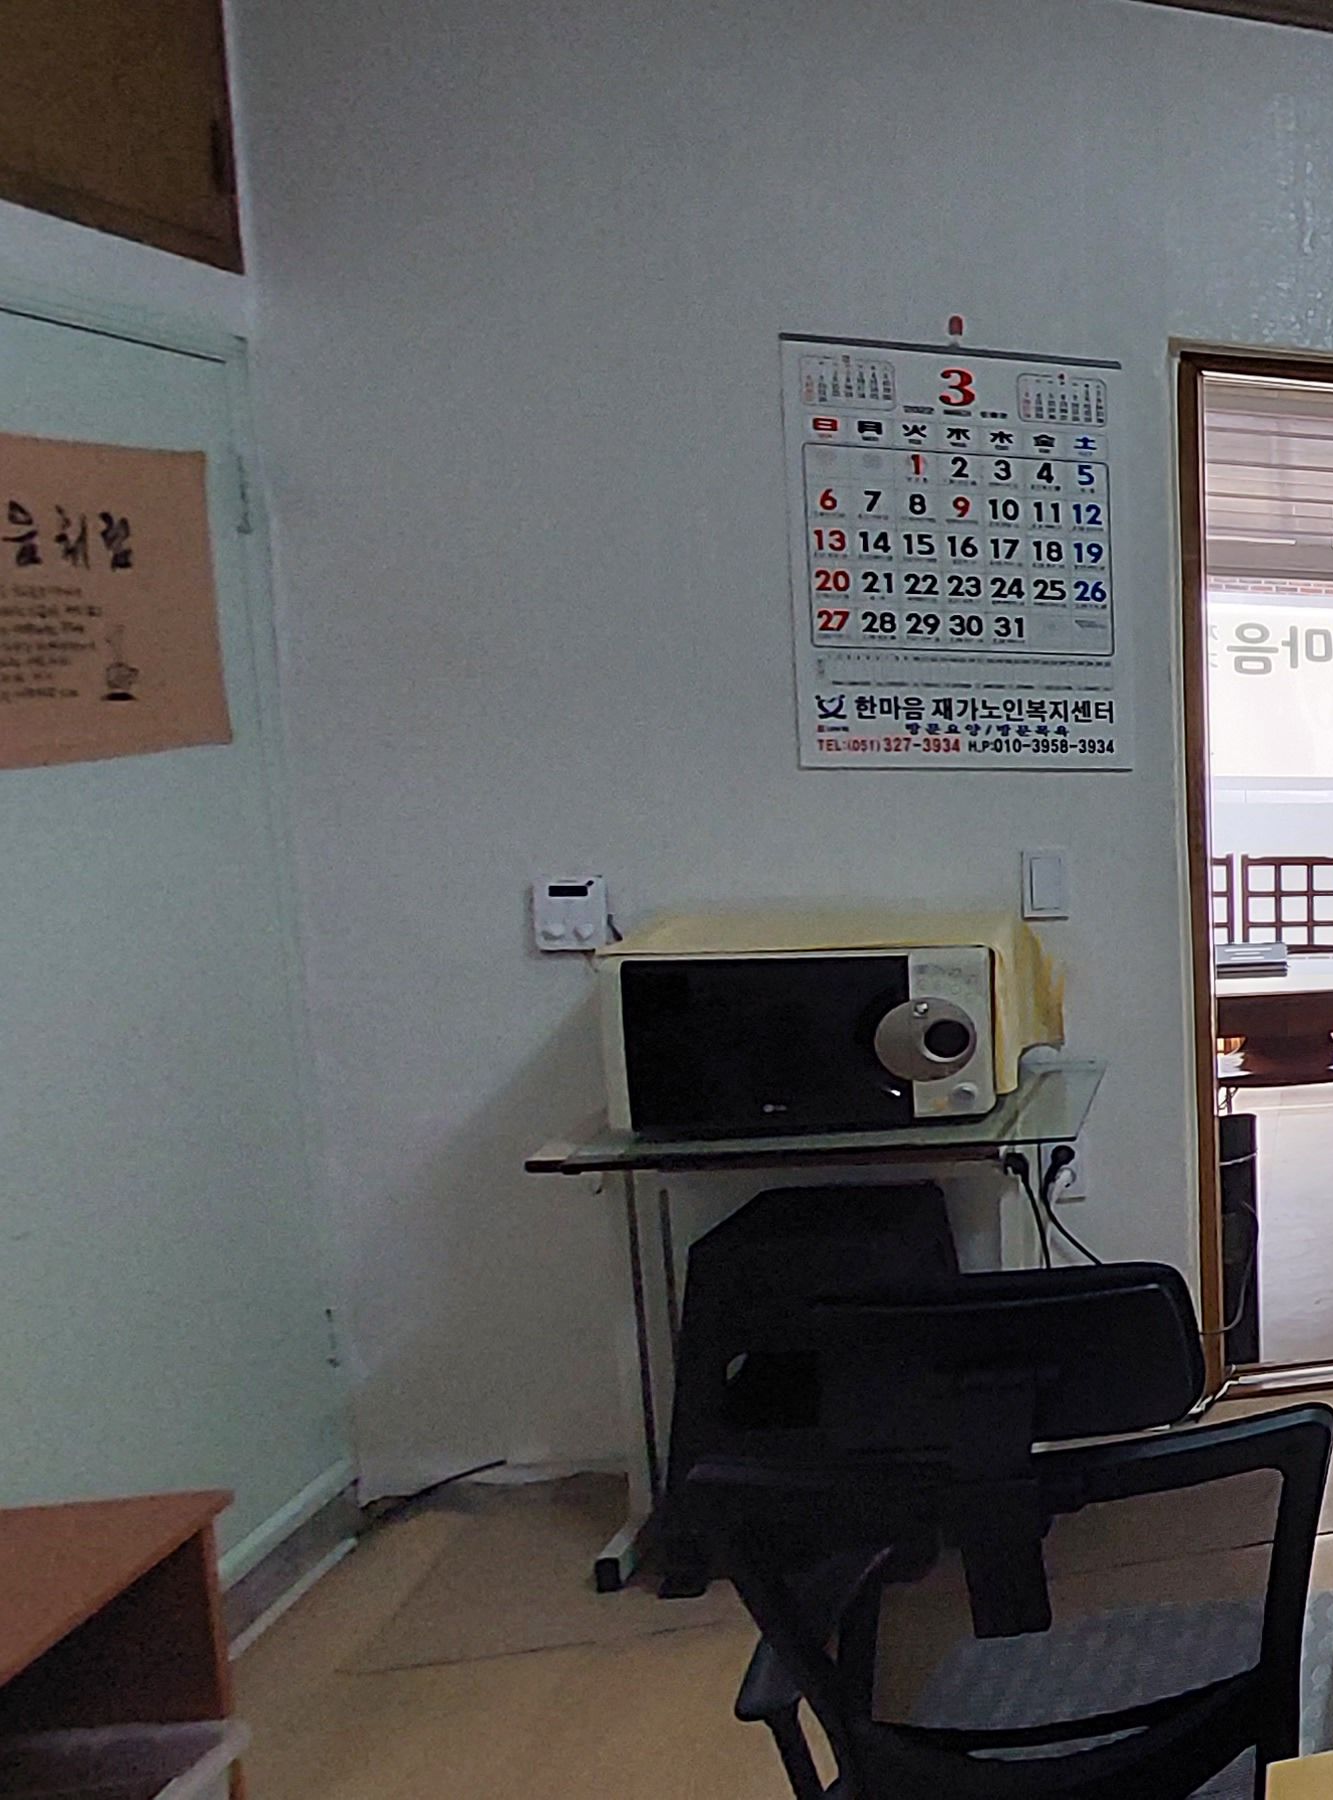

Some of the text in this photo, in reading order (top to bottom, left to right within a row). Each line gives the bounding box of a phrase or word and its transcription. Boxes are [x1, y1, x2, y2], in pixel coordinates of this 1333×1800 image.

[938, 369, 976, 407] 3
[811, 418, 838, 432] 日
[857, 421, 883, 435] 月
[902, 424, 927, 438] 火
[1032, 434, 1056, 448] 金
[1073, 437, 1097, 450] 土
[911, 454, 1095, 485] 1 2 3 4 5
[819, 488, 1102, 525] 6 7 8 9 10 11 12
[814, 529, 1103, 564] 13 14 15 16 17 18 19
[815, 569, 1107, 602] 20 21 22 23 24 25 26
[817, 609, 1024, 638] 27 28 29 30 31
[855, 695, 1115, 724] 한마음 재가노인복지센터
